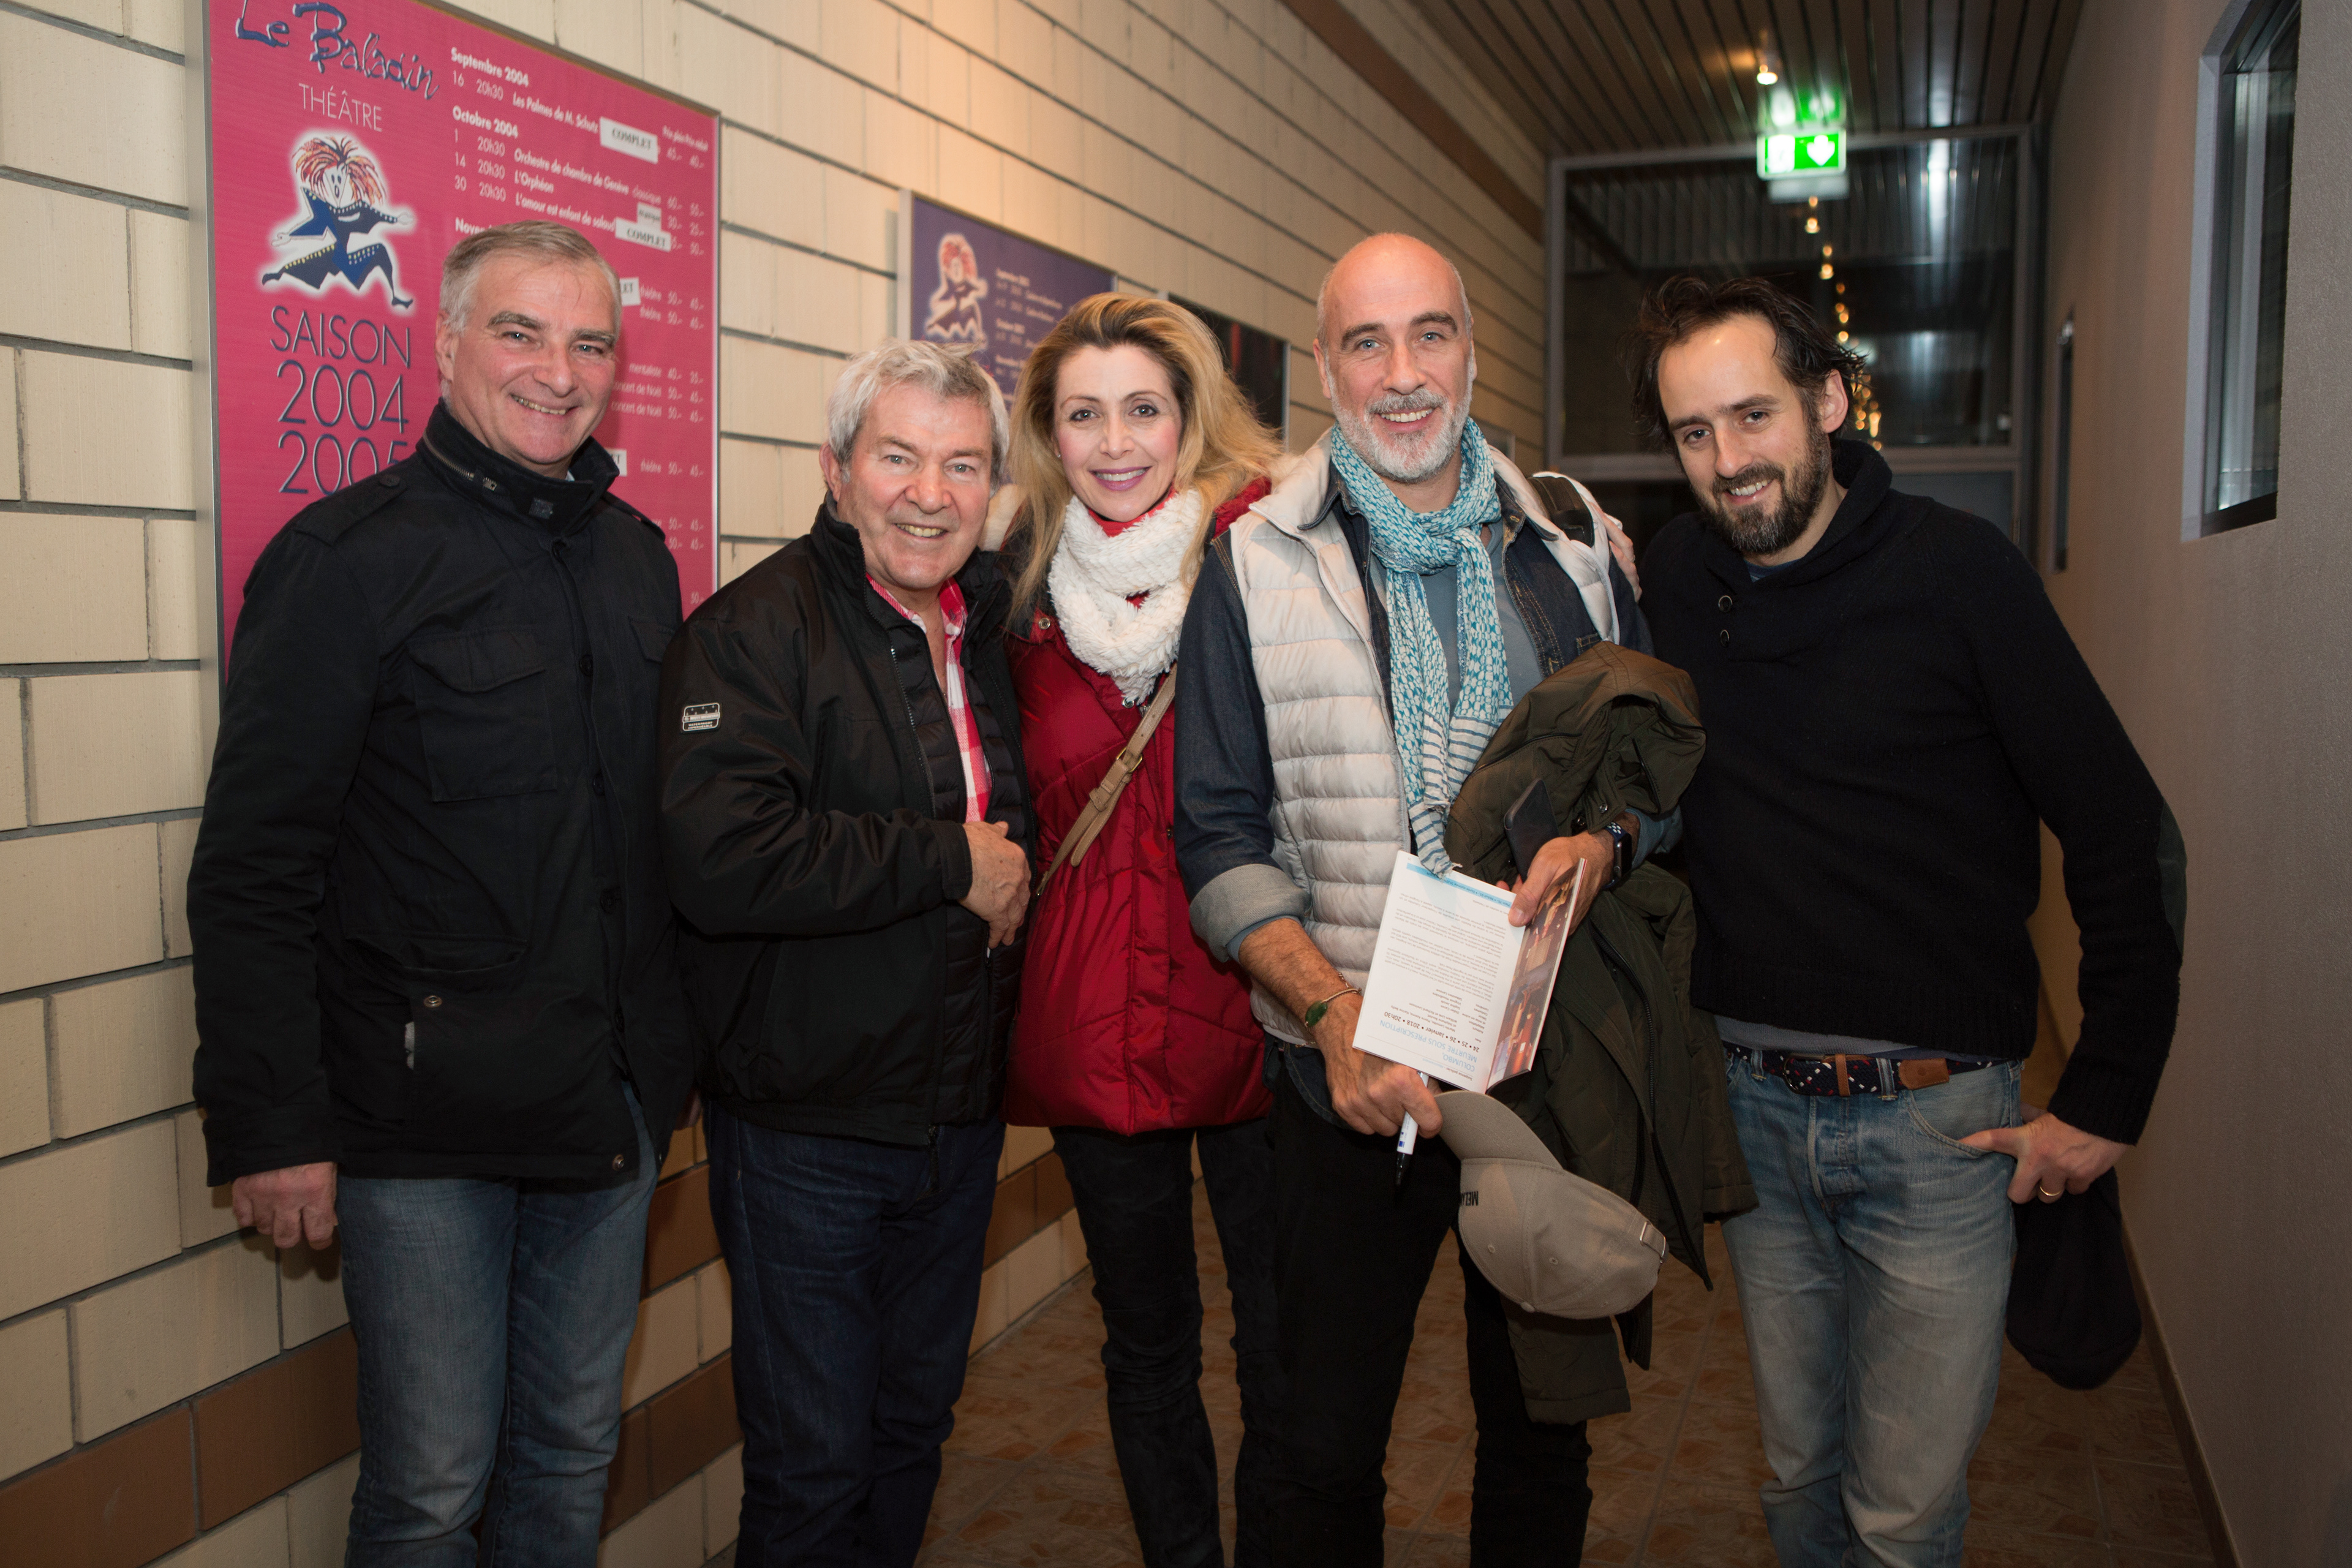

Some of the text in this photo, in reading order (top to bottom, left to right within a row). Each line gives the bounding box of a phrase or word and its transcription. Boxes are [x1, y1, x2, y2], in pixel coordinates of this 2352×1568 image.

[235, 0, 440, 100] Le Baladin
[451, 47, 529, 88] Septembre 2004
[298, 83, 383, 132] THÉÂTRE
[453, 70, 464, 87] 16
[477, 78, 503, 101] 20h30
[513, 91, 525, 108] Les
[526, 96, 552, 118] Palmes
[554, 105, 564, 121] de
[453, 105, 519, 139] Octobre 2004
[612, 128, 651, 149] COMPLET
[454, 128, 458, 143] 1
[477, 135, 505, 157] 20h30
[514, 147, 550, 171] Orchestre
[551, 158, 562, 175] de
[562, 162, 593, 184] chambre
[593, 171, 603, 187] de
[603, 175, 630, 195] Genève
[455, 151, 554, 194] 14 20h30 L'Orphéon
[454, 175, 467, 192] 30
[478, 181, 506, 202] 20h30
[515, 191, 546, 213] L'amour
[546, 203, 558, 216] est
[559, 205, 581, 223] enfant
[582, 210, 592, 226] de
[627, 228, 666, 247] COMPLET
[270, 305, 410, 369] SAISON
[277, 359, 409, 434] 2004
[636, 383, 646, 396] de
[636, 403, 646, 415] de
[641, 459, 662, 474] théâtre
[1384, 1011, 1401, 1022] 20h30
[1406, 1020, 1420, 1029] 2018
[1425, 1027, 1445, 1038] Janvier
[1380, 1020, 1477, 1063] MEURTRE SOUS PRESCRIPTION
[1442, 1053, 1475, 1072] COLUMBO,
[1458, 1072, 1472, 1081] Suspense
